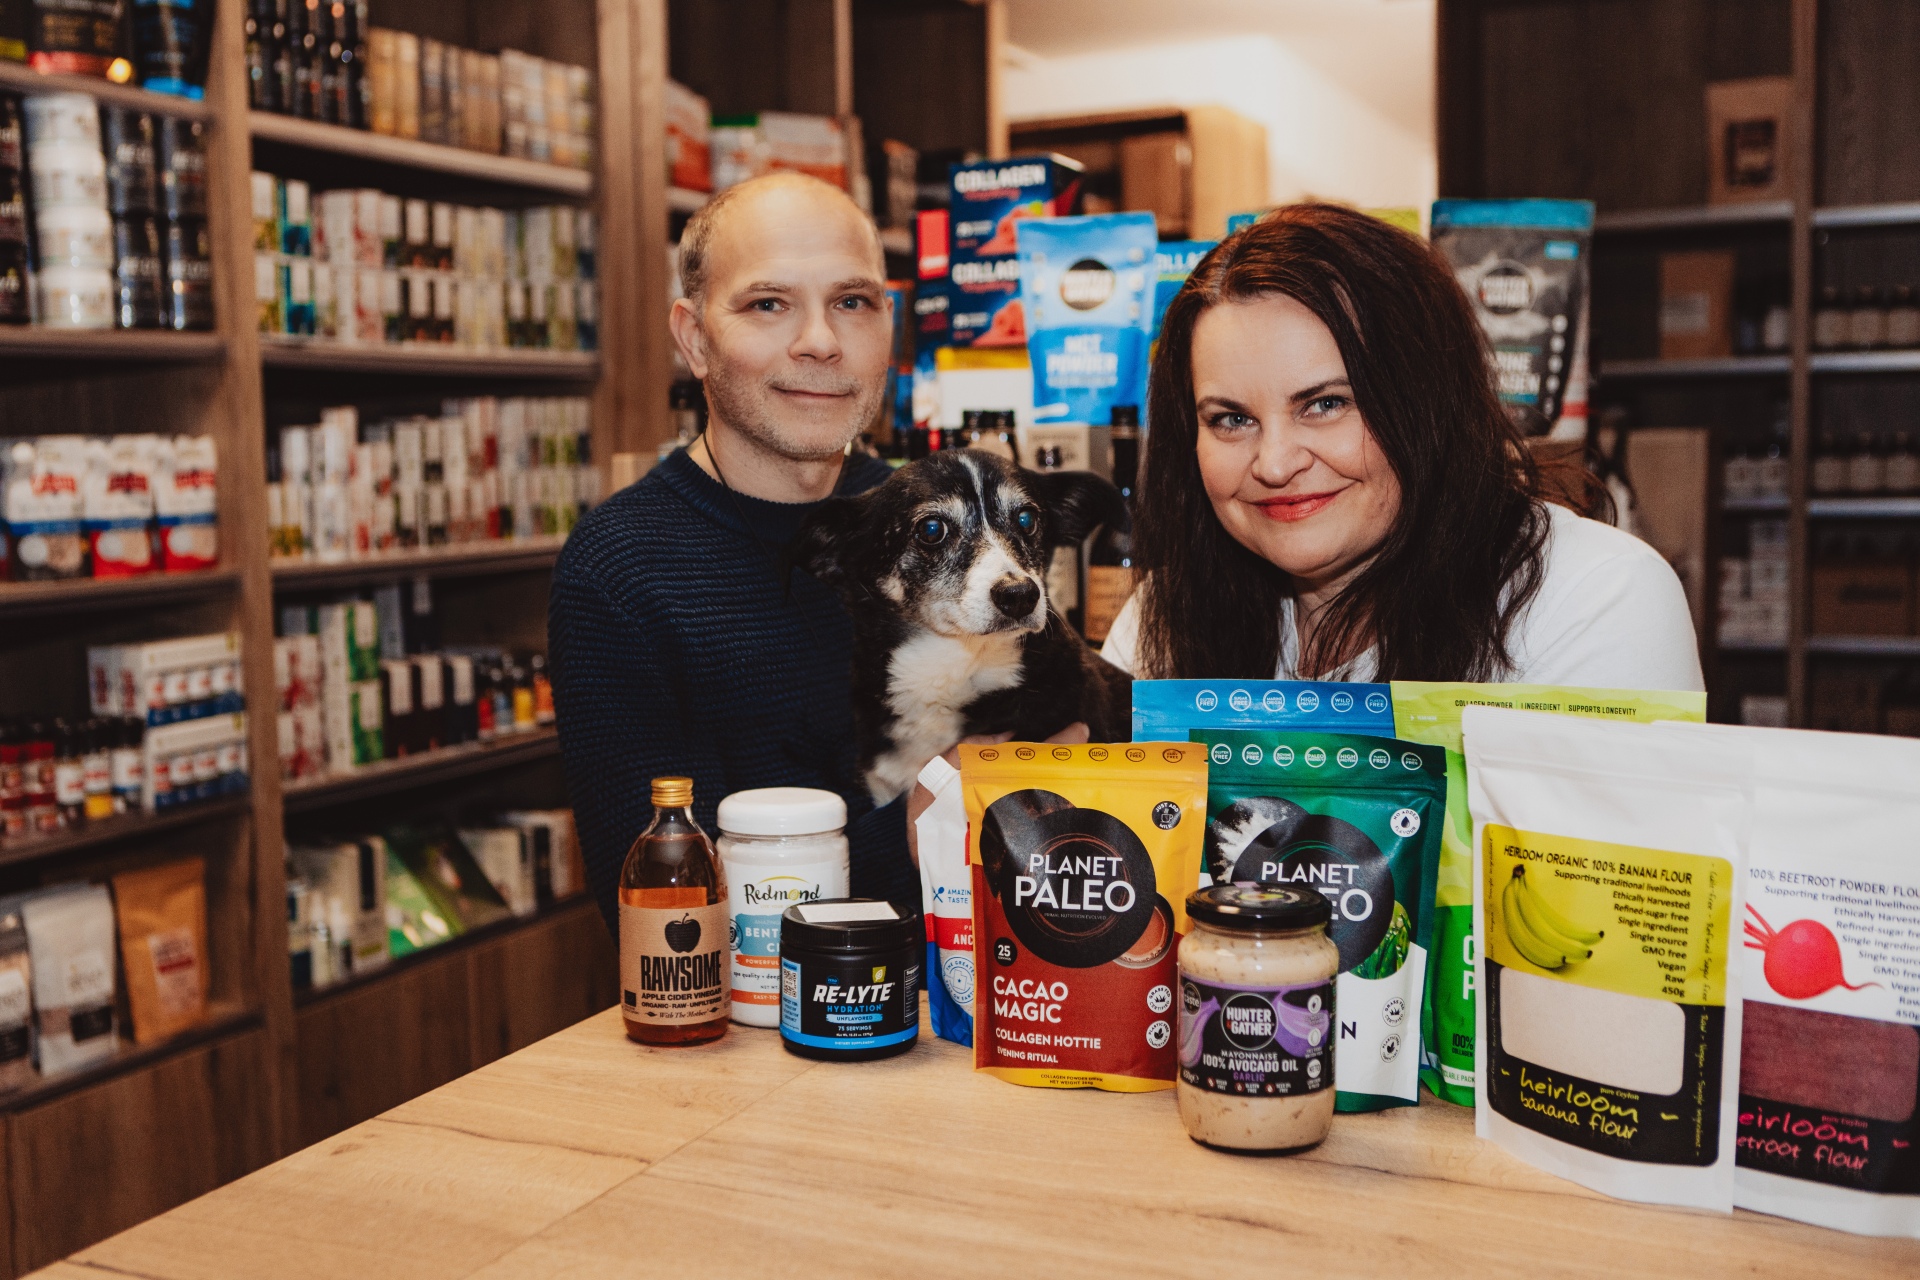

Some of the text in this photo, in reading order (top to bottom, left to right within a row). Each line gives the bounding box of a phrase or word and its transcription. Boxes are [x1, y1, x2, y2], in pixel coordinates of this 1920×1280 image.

[954, 164, 1046, 193] COLLAGEN
[952, 259, 1020, 285] COLLAG
[1524, 703, 1561, 712] INGREDIENT
[1568, 704, 1637, 716] SUPPORTS LONGEVITY
[1155, 802, 1179, 812] JUST ADD
[1393, 809, 1418, 821] NO ADDED
[1395, 825, 1417, 836] FLAVOUR
[1029, 853, 1123, 877] PLANET
[1503, 844, 1693, 885] HEIRLOOM ORGANIC 100% BANANA FLOUR
[1260, 861, 1359, 885] PLANET
[1554, 869, 1600, 885] Supporting
[1603, 877, 1645, 891] traditional
[1646, 882, 1691, 898] livelihoods
[1749, 868, 1920, 898] 100% BEETROOT POWDER/ FLOU
[743, 883, 822, 905] Redmond
[948, 896, 969, 904] TASTE
[1015, 875, 1136, 913] PALEO
[1612, 890, 1690, 910] Ethically Harvested
[1765, 885, 1920, 912] Supporting traditional livelihoo
[1614, 903, 1689, 922] Refined-sugar free
[1834, 907, 1920, 925] Ethically Harveste
[745, 927, 779, 938] BENT
[1618, 916, 1688, 934] Single ingredient
[1836, 921, 1920, 939] Refined-sugar fre
[953, 934, 973, 945] ANC
[1630, 931, 1688, 947] Single source
[1842, 935, 1920, 952] Single ingredien
[998, 944, 1011, 957] 25
[1642, 945, 1687, 960] GMO free
[1858, 950, 1888, 962] Single
[745, 958, 780, 966] POWERFUL
[1657, 960, 1686, 972] Vegan
[641, 950, 721, 992] RAWSOME
[742, 973, 760, 981] quality
[1873, 966, 1899, 976] GMO
[1664, 974, 1685, 985] Raw
[641, 987, 722, 1001] APPLE CIDER VINEGAR
[812, 982, 893, 1004] RE-LYTE
[993, 975, 1069, 1002] CACAO
[1149, 987, 1164, 1000] GRASS
[1661, 986, 1685, 998] 450g
[827, 1004, 882, 1013] HYDRATION
[994, 997, 1062, 1024] MAGIC
[1149, 1001, 1170, 1011] CERTIFIED
[1226, 1006, 1272, 1022] HUNTER
[675, 1011, 686, 1019] The
[1148, 1023, 1163, 1035] PLASTIC
[1231, 1021, 1272, 1036] GATHER
[995, 1027, 1102, 1050] COLLAGEN HOTTIE
[1452, 1033, 1474, 1050] 100%
[997, 1046, 1058, 1064] EVENING RITUAL
[1202, 1053, 1299, 1073] 100% AVOCADO OIL
[1221, 1050, 1278, 1061] MAYONNAISE
[1233, 1071, 1265, 1082] GARLIC
[1443, 1069, 1460, 1081] CLABLE
[1520, 1066, 1638, 1124] heirloom
[1600, 1086, 1640, 1101] pure Ceylon
[1520, 1091, 1638, 1139] banana flour
[1738, 1105, 1869, 1151] eirloom
[1736, 1135, 1869, 1170] etroot flour
